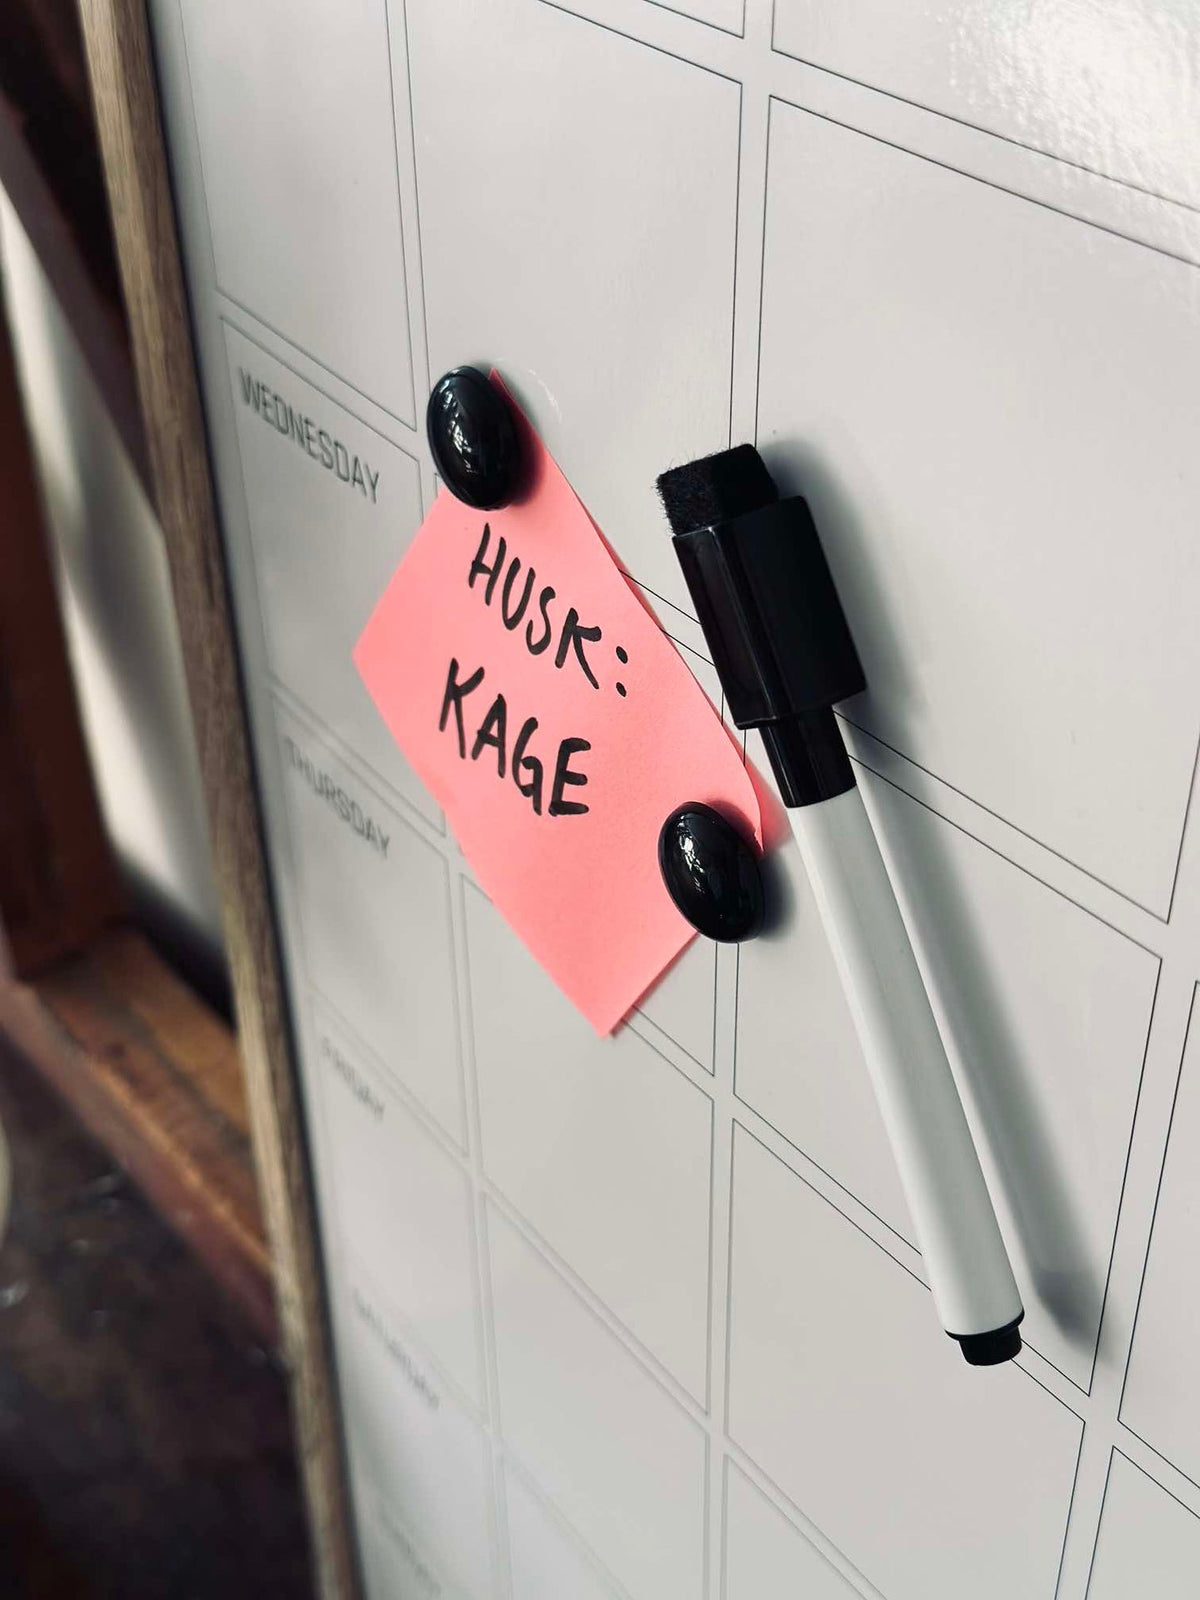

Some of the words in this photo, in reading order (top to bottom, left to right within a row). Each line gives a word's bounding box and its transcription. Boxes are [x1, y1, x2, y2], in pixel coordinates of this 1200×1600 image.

[238, 366, 380, 504] WEDNESDAY
[468, 522, 628, 697] HUSK:
[284, 735, 391, 859] THURSDAY
[438, 657, 591, 817] KAGE
